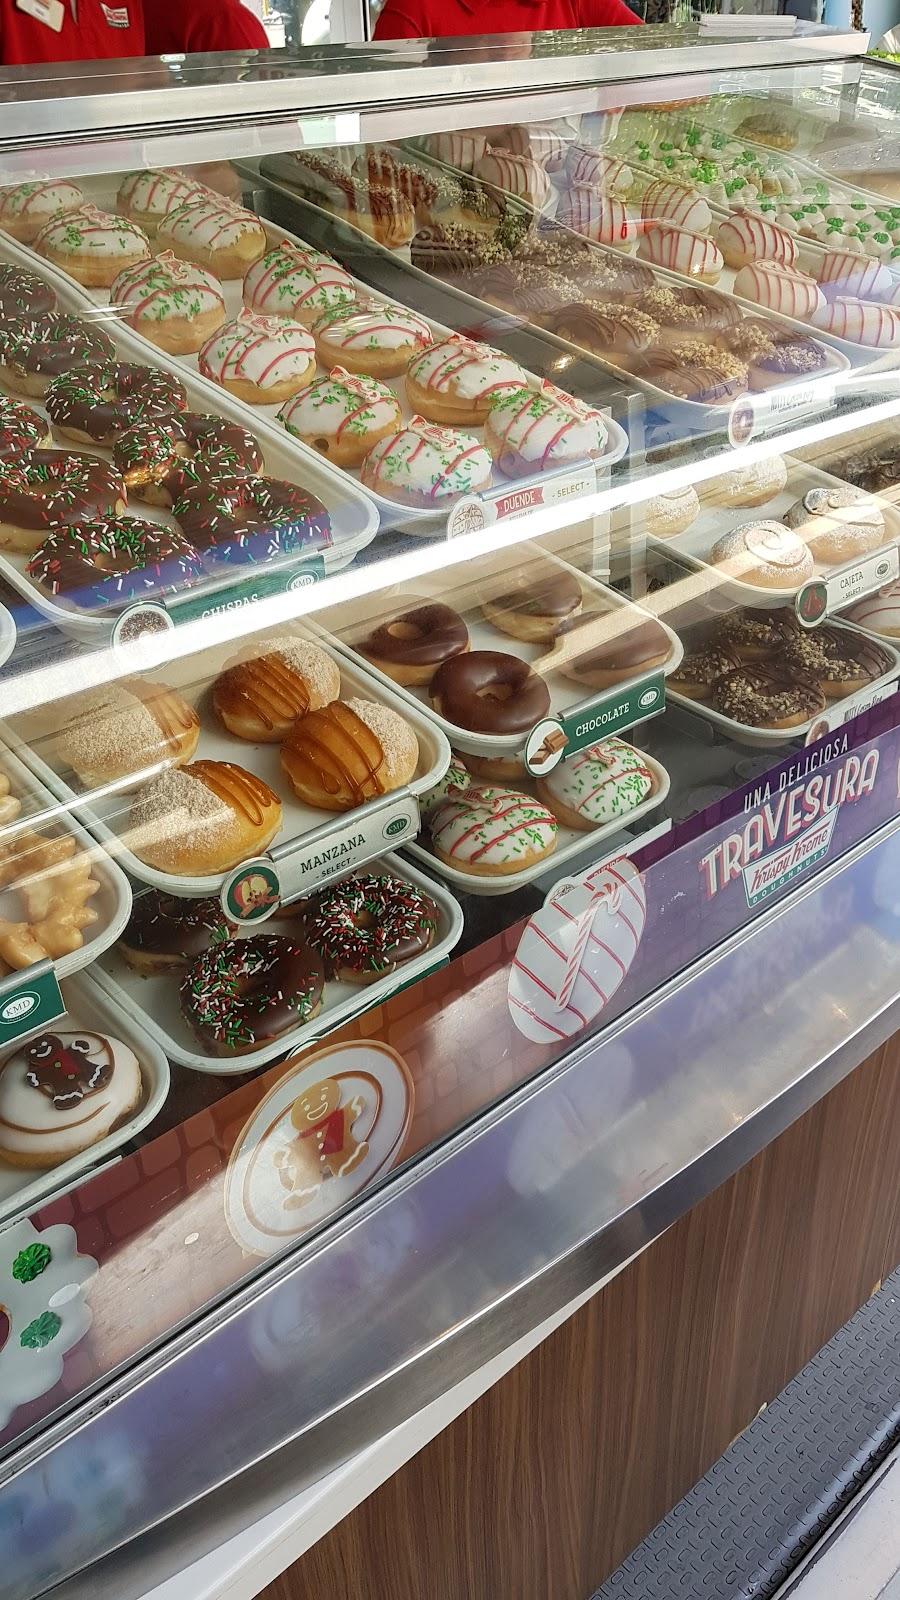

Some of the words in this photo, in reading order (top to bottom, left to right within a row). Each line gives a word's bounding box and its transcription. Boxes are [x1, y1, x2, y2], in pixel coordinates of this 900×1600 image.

[503, 491, 536, 512] DUENDE
[557, 481, 586, 497] SELECT
[293, 576, 313, 590] KMD
[840, 571, 864, 589] CAJETA
[575, 702, 631, 737] CHOCOLATE
[744, 781, 772, 814] UNA
[779, 733, 849, 793] DELICIOSA
[700, 749, 880, 898] TRAVESURA
[300, 833, 367, 874] MANZANA
[750, 846, 793, 894] Krispy
[790, 822, 831, 863] Kreme
[321, 859, 352, 878] SELECT
[752, 848, 827, 904] DOUGHNUTS
[5, 999, 31, 1017] KMD
